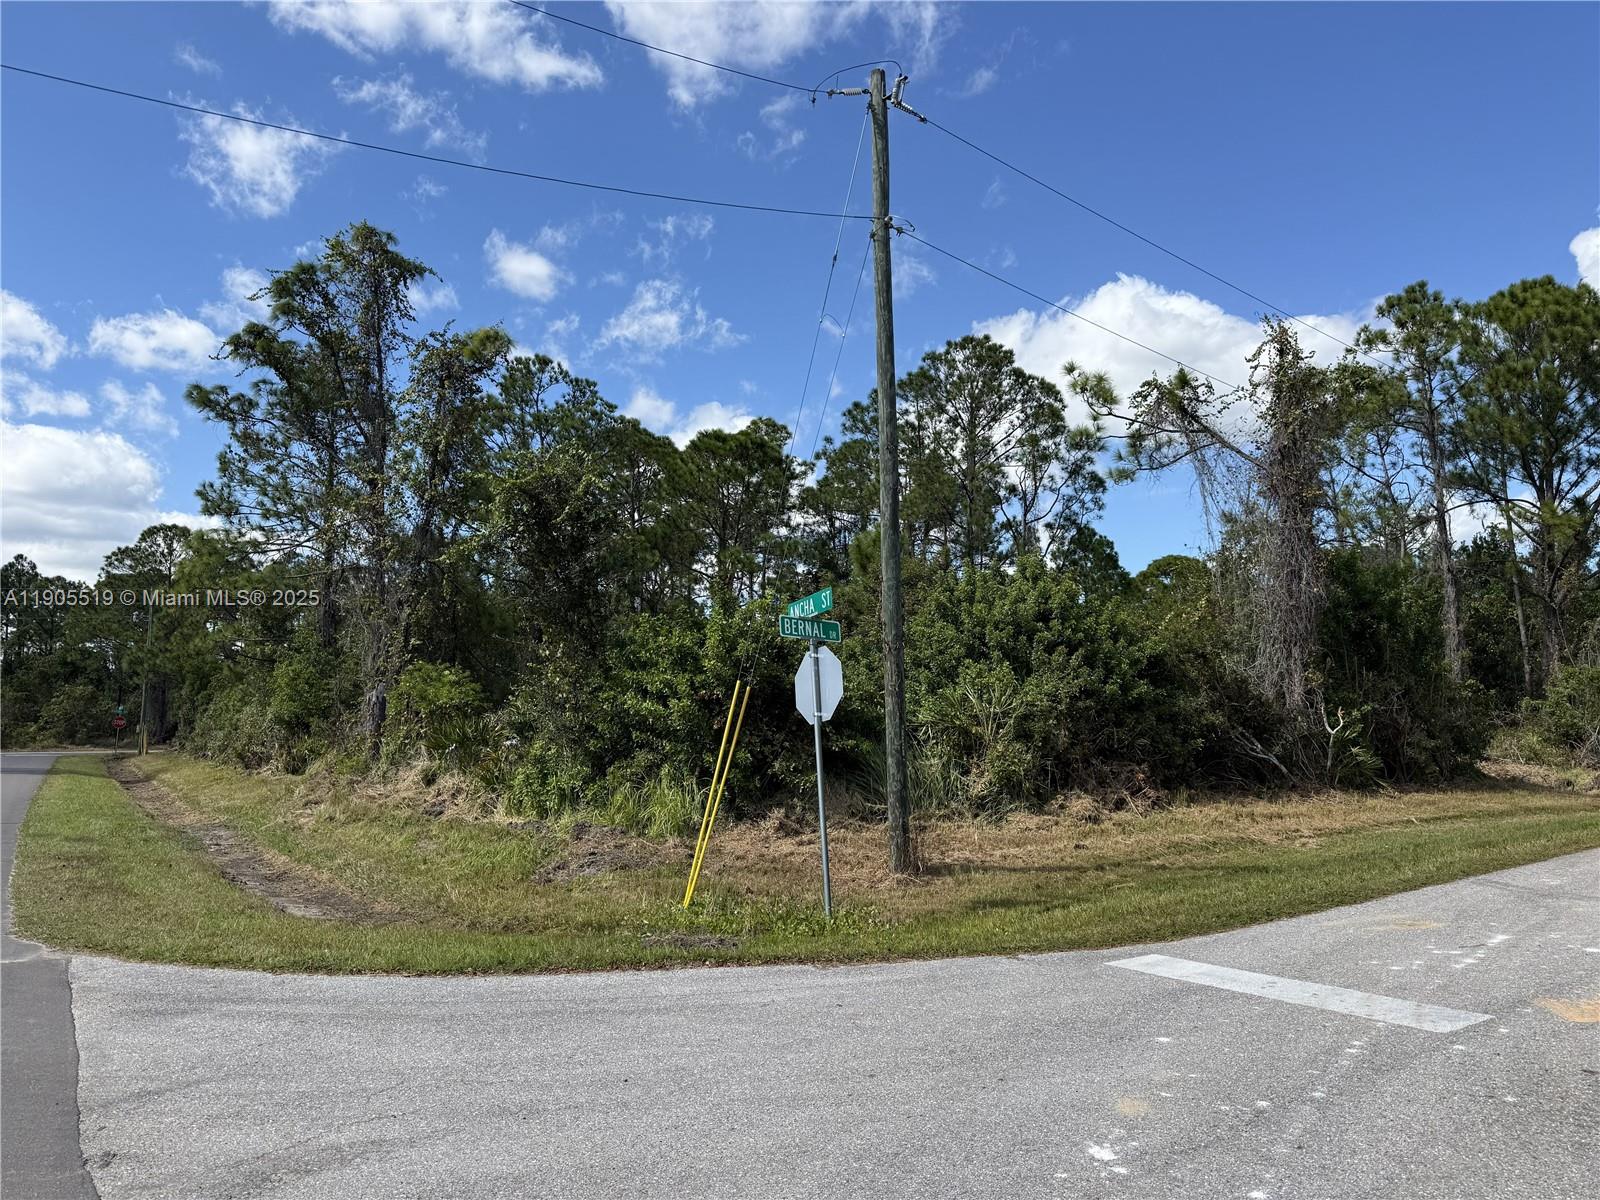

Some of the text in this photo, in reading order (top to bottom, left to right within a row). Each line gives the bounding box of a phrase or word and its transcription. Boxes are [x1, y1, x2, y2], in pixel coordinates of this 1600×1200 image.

[790, 591, 830, 617] ANCHA ST
[784, 618, 837, 640] BERNAL DR
